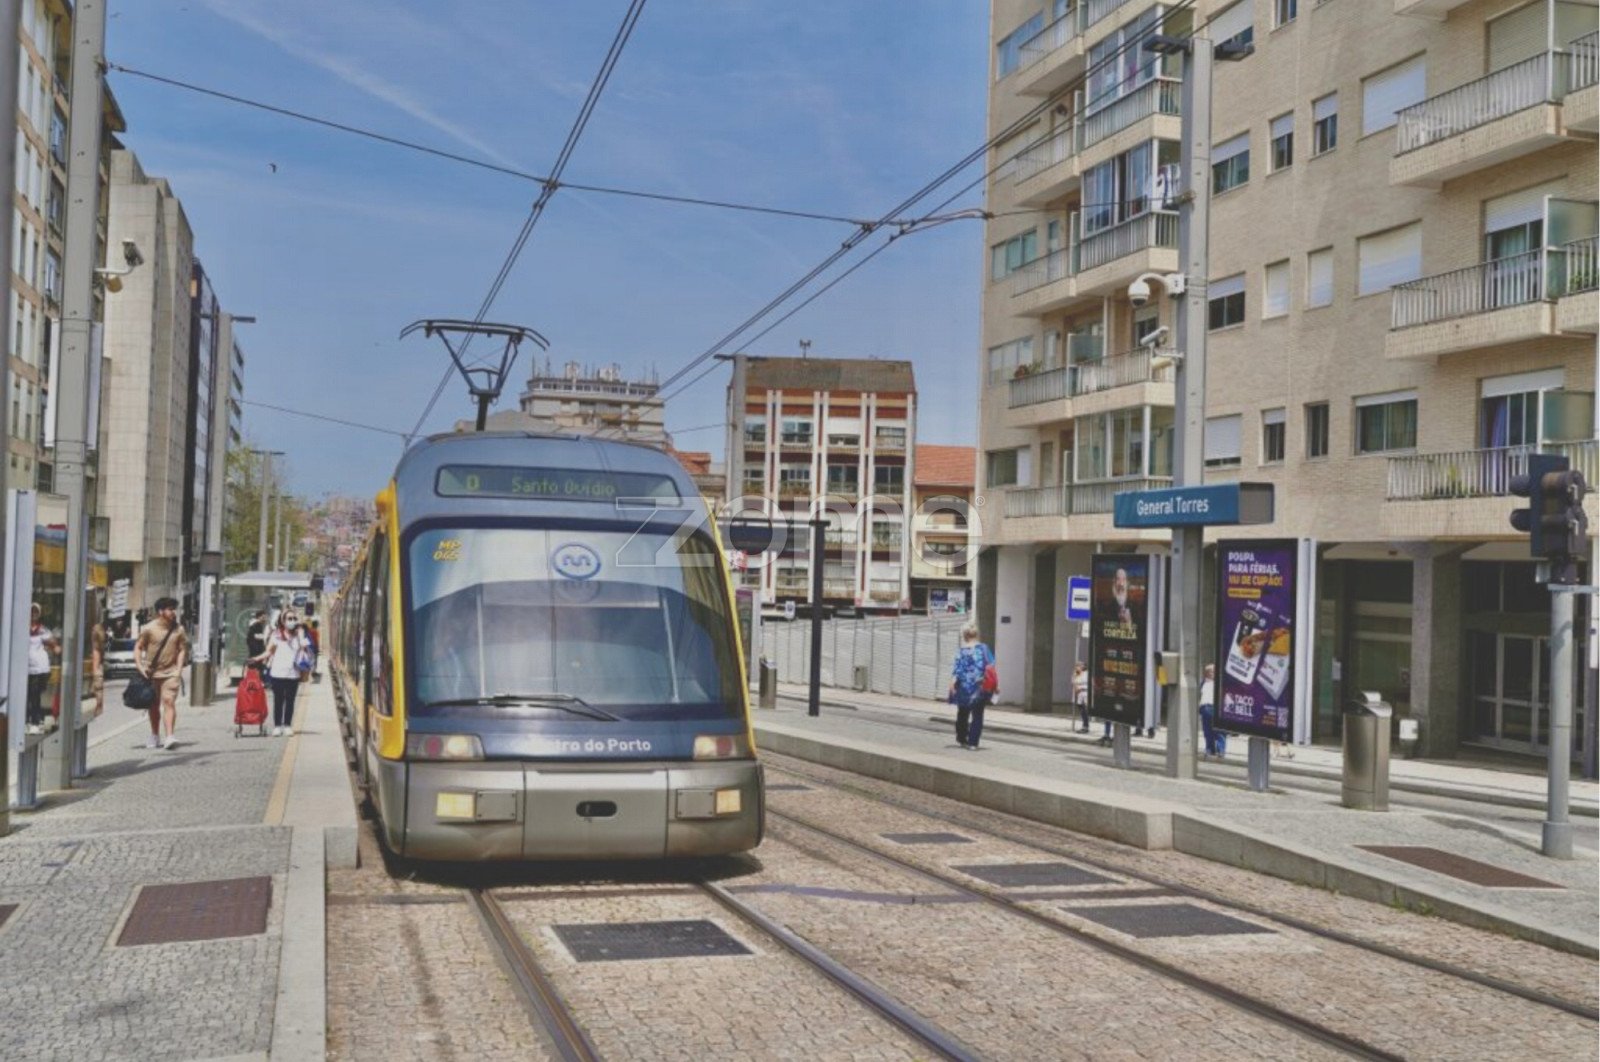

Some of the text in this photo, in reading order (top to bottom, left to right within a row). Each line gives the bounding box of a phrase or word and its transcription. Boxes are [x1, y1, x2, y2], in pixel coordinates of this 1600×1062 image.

[511, 475, 558, 495] Santo
[1136, 496, 1209, 516] General Torres
[1228, 551, 1255, 562] POUPA
[1228, 563, 1249, 573] PARA
[1234, 694, 1254, 707] TACO
[583, 738, 604, 751] do
[607, 738, 651, 752] Porto
